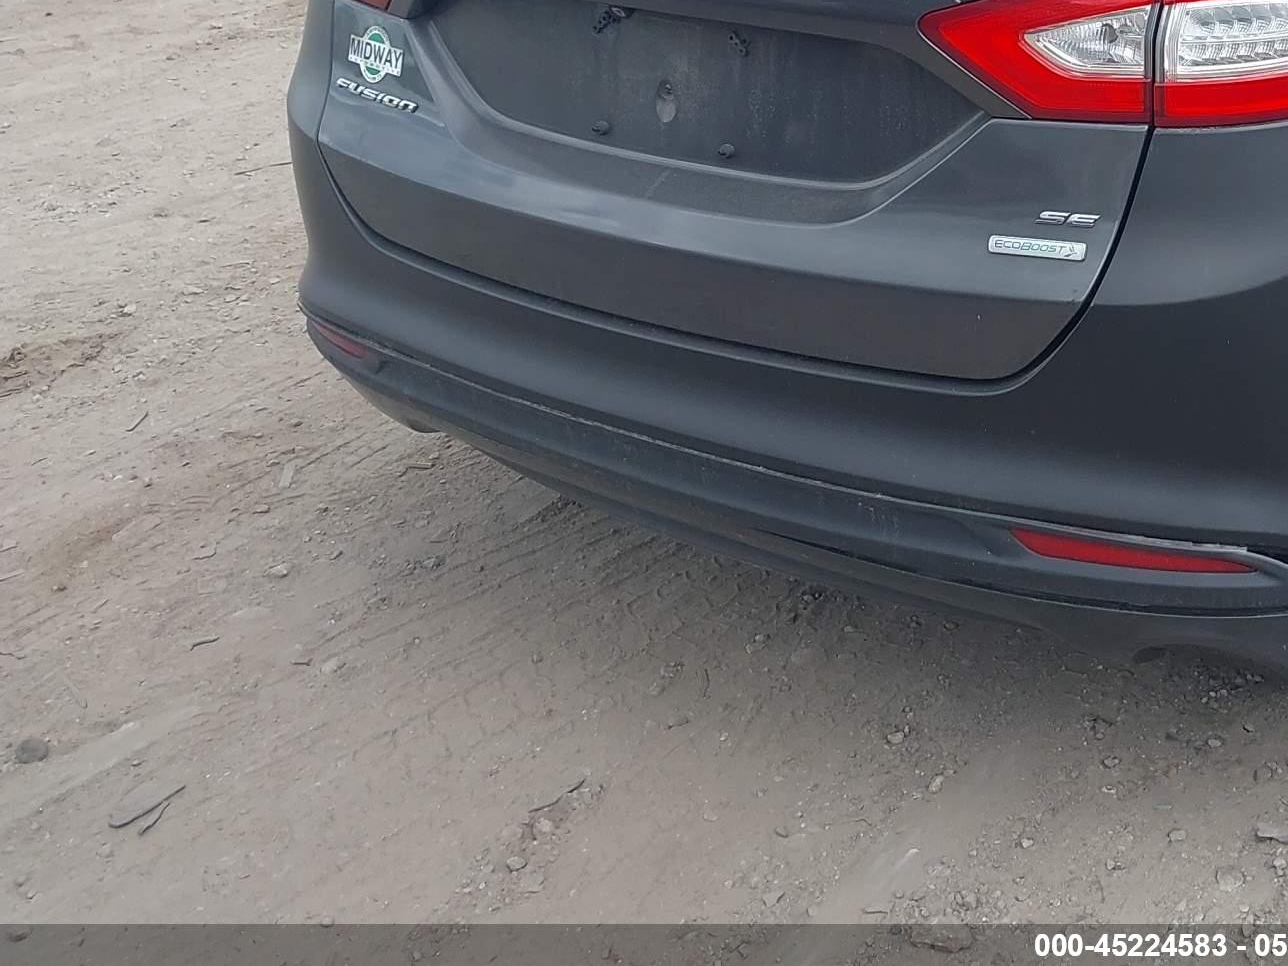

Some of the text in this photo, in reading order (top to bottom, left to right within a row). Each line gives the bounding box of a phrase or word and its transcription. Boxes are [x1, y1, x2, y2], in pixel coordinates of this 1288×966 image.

[350, 37, 402, 69] MIDWAY
[1034, 210, 1101, 228] SE
[994, 239, 1067, 255] ECOBOOST
